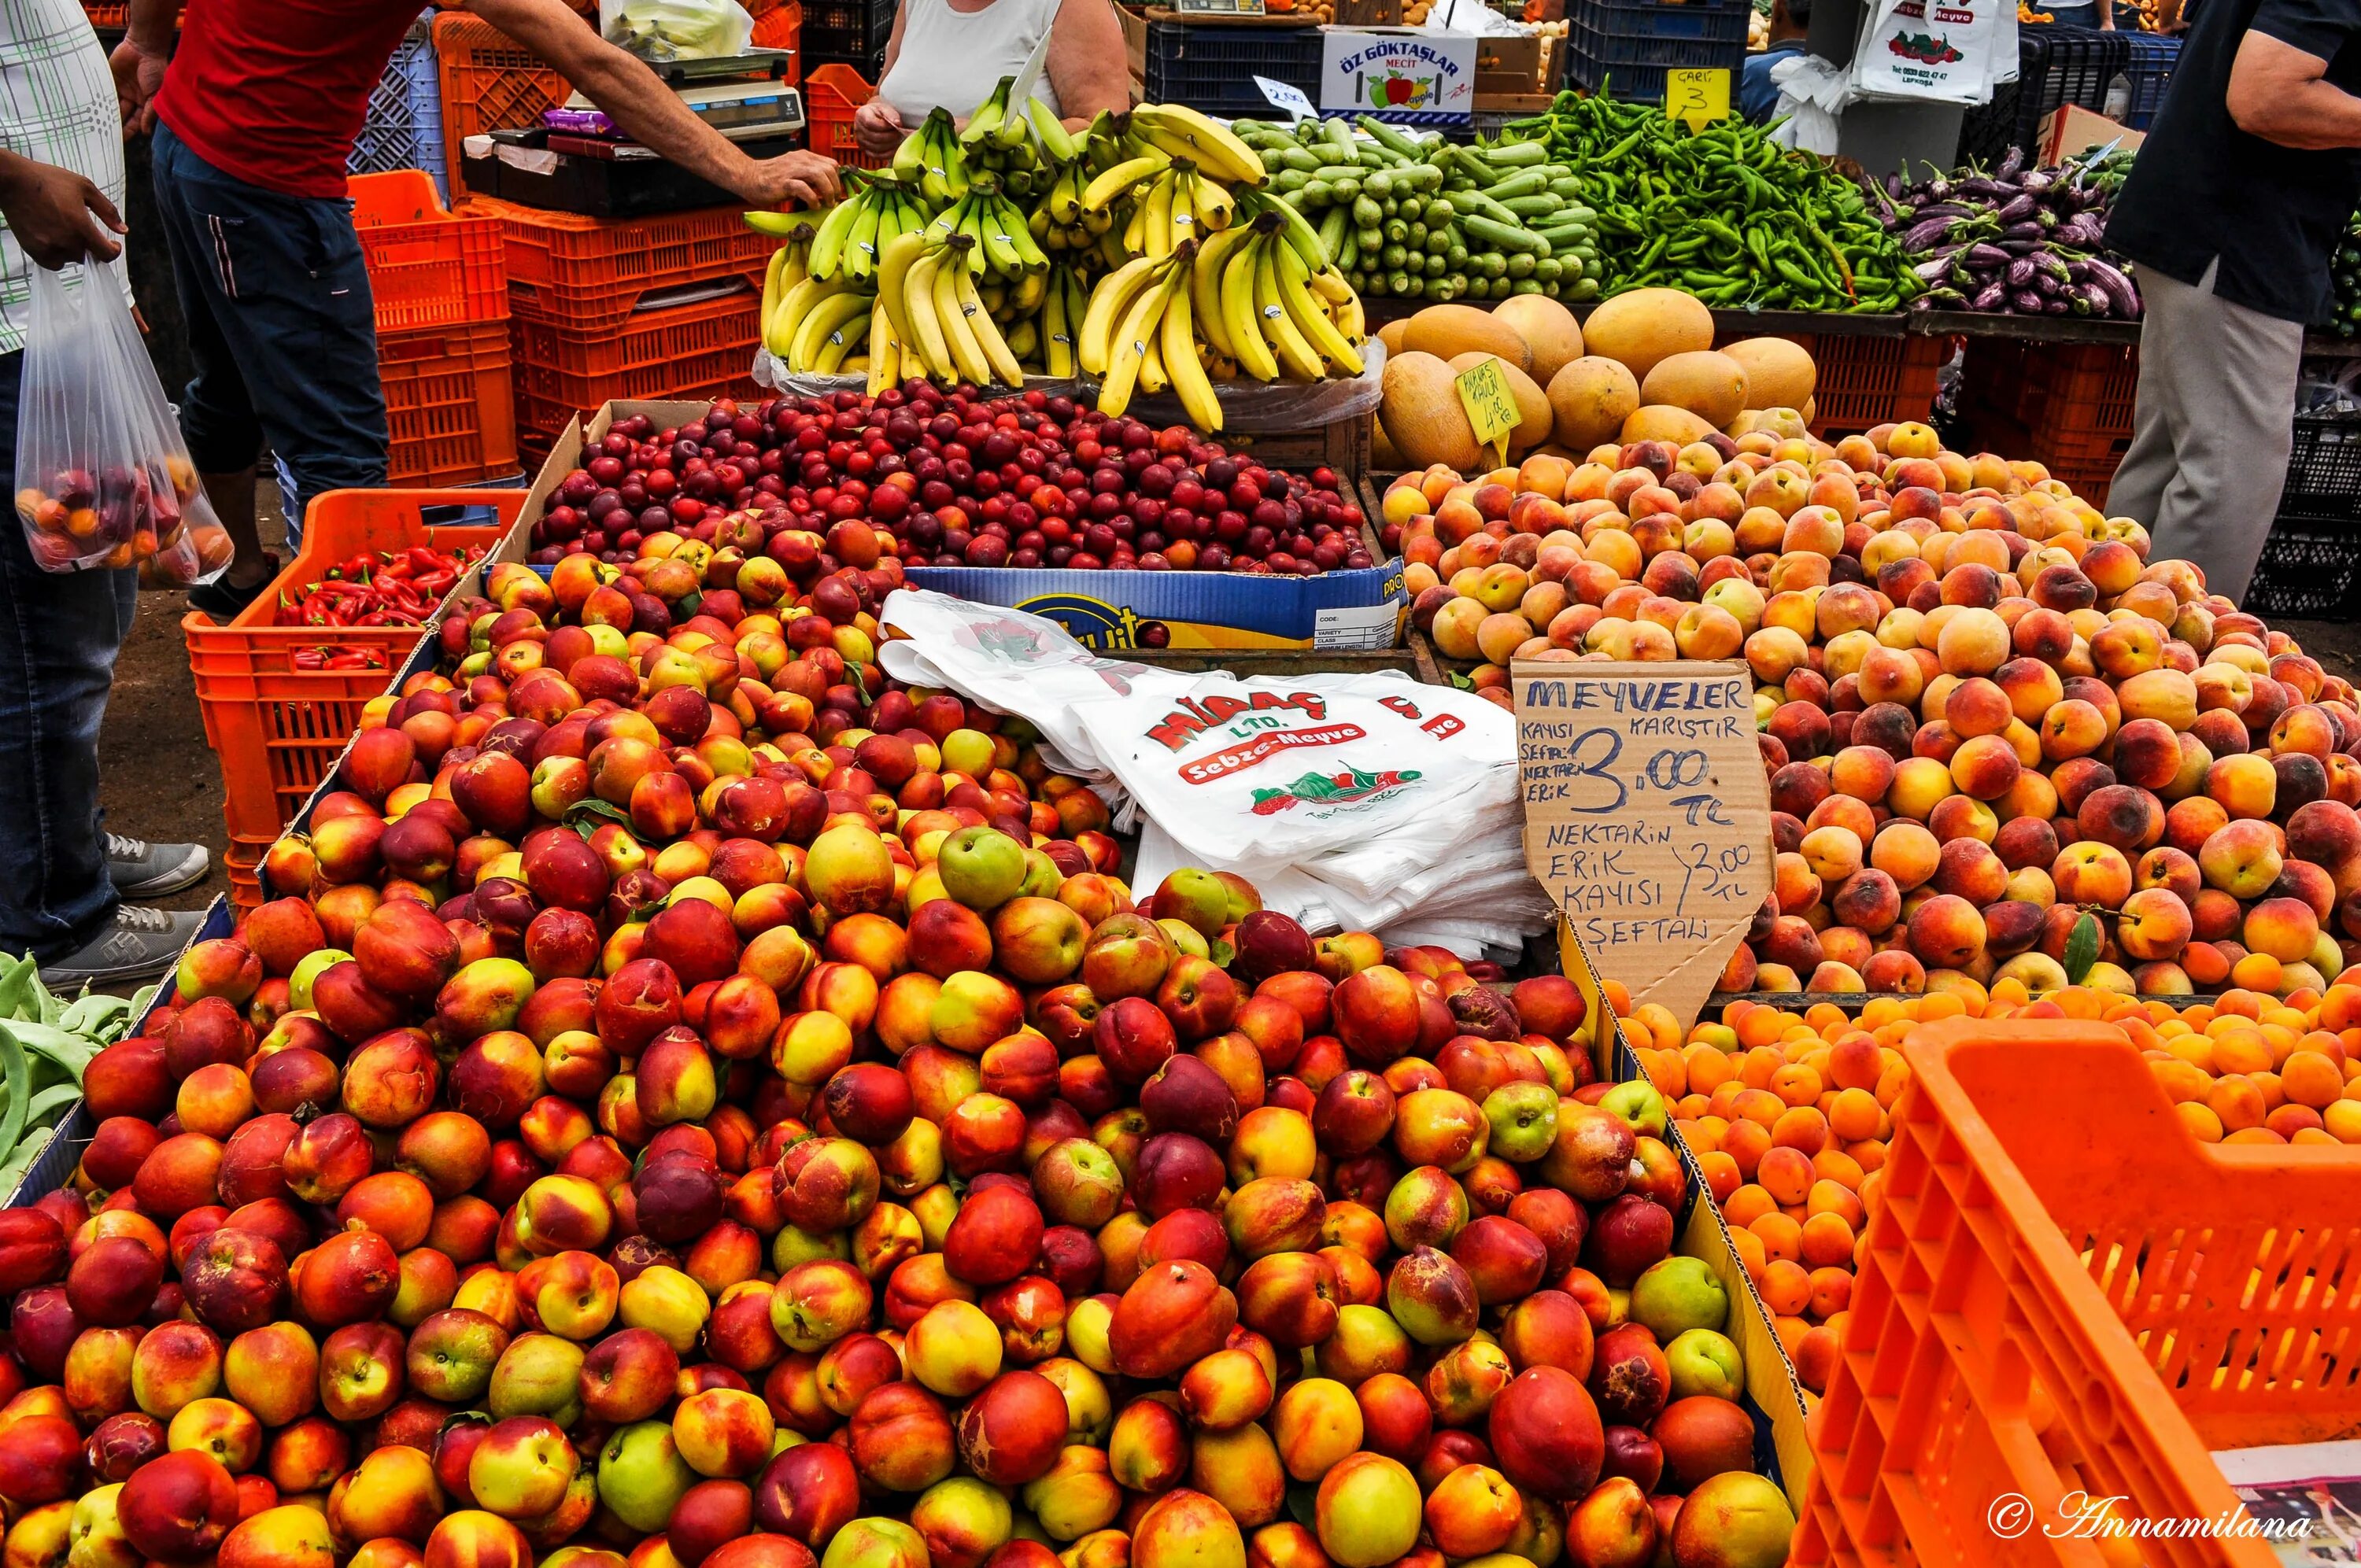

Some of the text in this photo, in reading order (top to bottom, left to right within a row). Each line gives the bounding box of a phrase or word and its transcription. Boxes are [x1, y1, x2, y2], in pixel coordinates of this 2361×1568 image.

[1339, 40, 1459, 78] ÖZ GÖKTAŞLAR
[1385, 57, 1417, 68] MECİT
[1409, 90, 1434, 106] apple
[1681, 87, 1708, 109] 3
[1526, 680, 1748, 713] MEYVELER
[1229, 716, 1289, 739] LTD.
[1521, 721, 1573, 740] KAYISI
[1629, 717, 1744, 739] KARIŞTIR
[1186, 727, 1360, 780] Sebze-Meyve
[1563, 878, 1661, 913] KAYISI
[1711, 883, 1748, 902] TL
